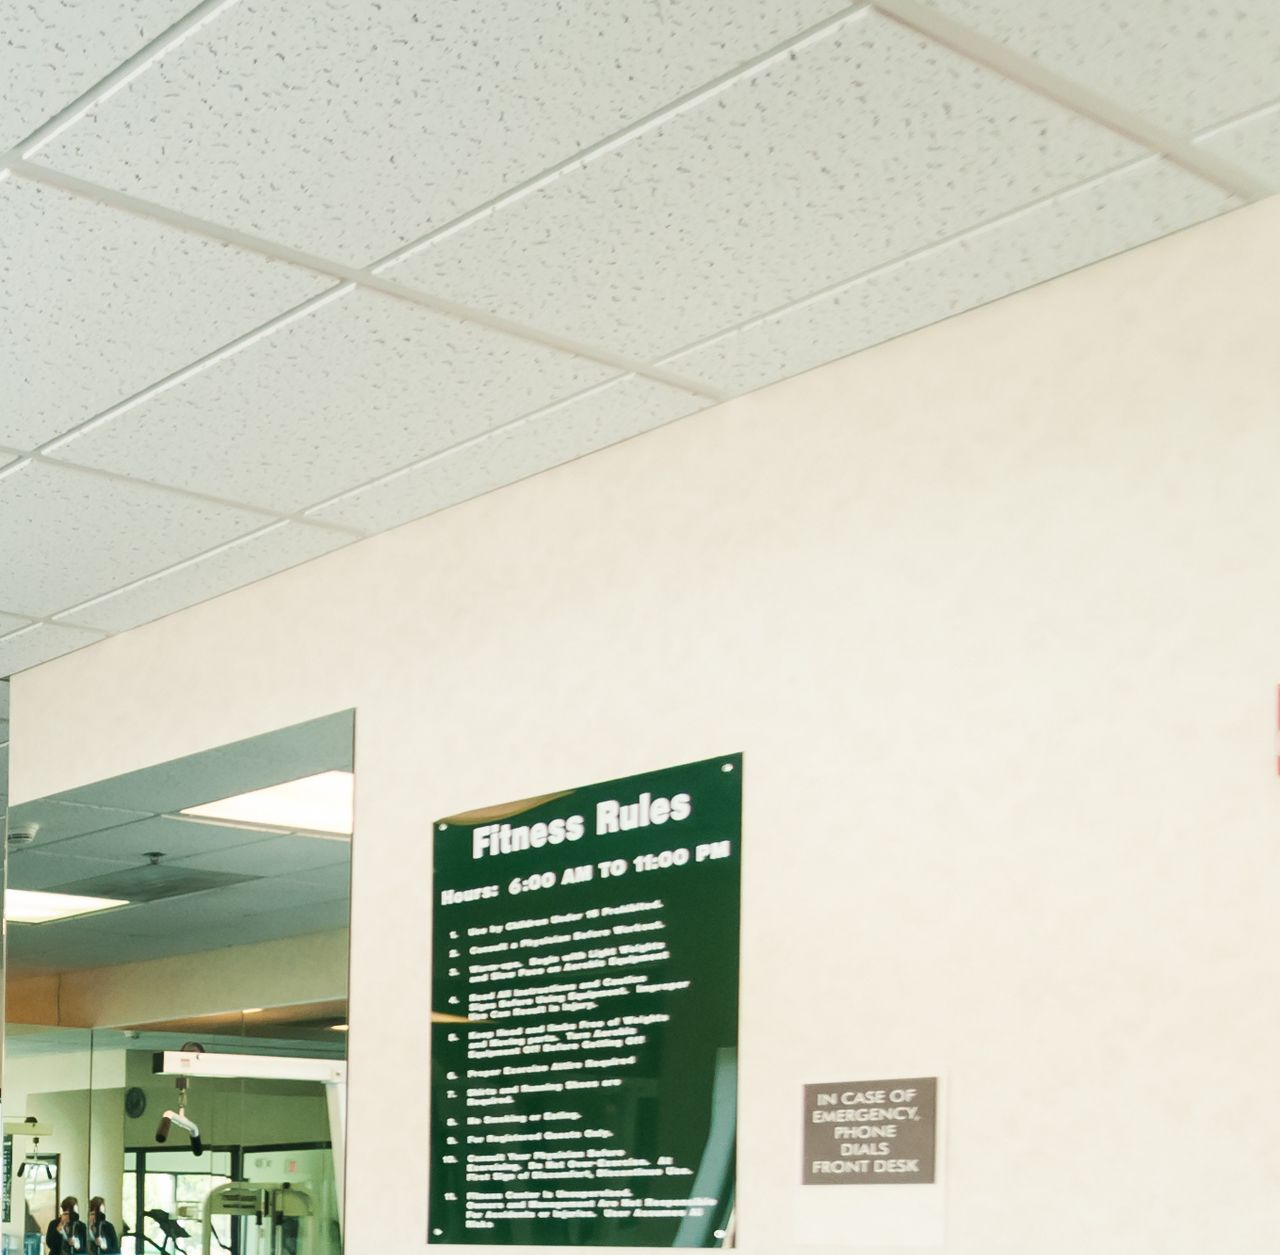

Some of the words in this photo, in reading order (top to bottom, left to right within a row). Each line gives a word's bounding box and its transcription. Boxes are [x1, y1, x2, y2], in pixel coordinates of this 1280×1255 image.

[472, 814, 585, 860] Fitness
[596, 792, 692, 836] Rules
[441, 884, 499, 906] Hours:
[508, 871, 557, 895] 6:00
[560, 864, 594, 886] AM
[597, 858, 628, 879] TO
[632, 847, 690, 873] 11:00
[695, 840, 731, 863] PM
[817, 1093, 837, 1106] IN
[841, 1090, 886, 1105] CASE
[889, 1089, 918, 1102] OF
[834, 1124, 897, 1139] PHONE
[840, 1142, 890, 1156] DIALS
[812, 1160, 870, 1173] FRONT
[873, 1159, 920, 1172] DESK
